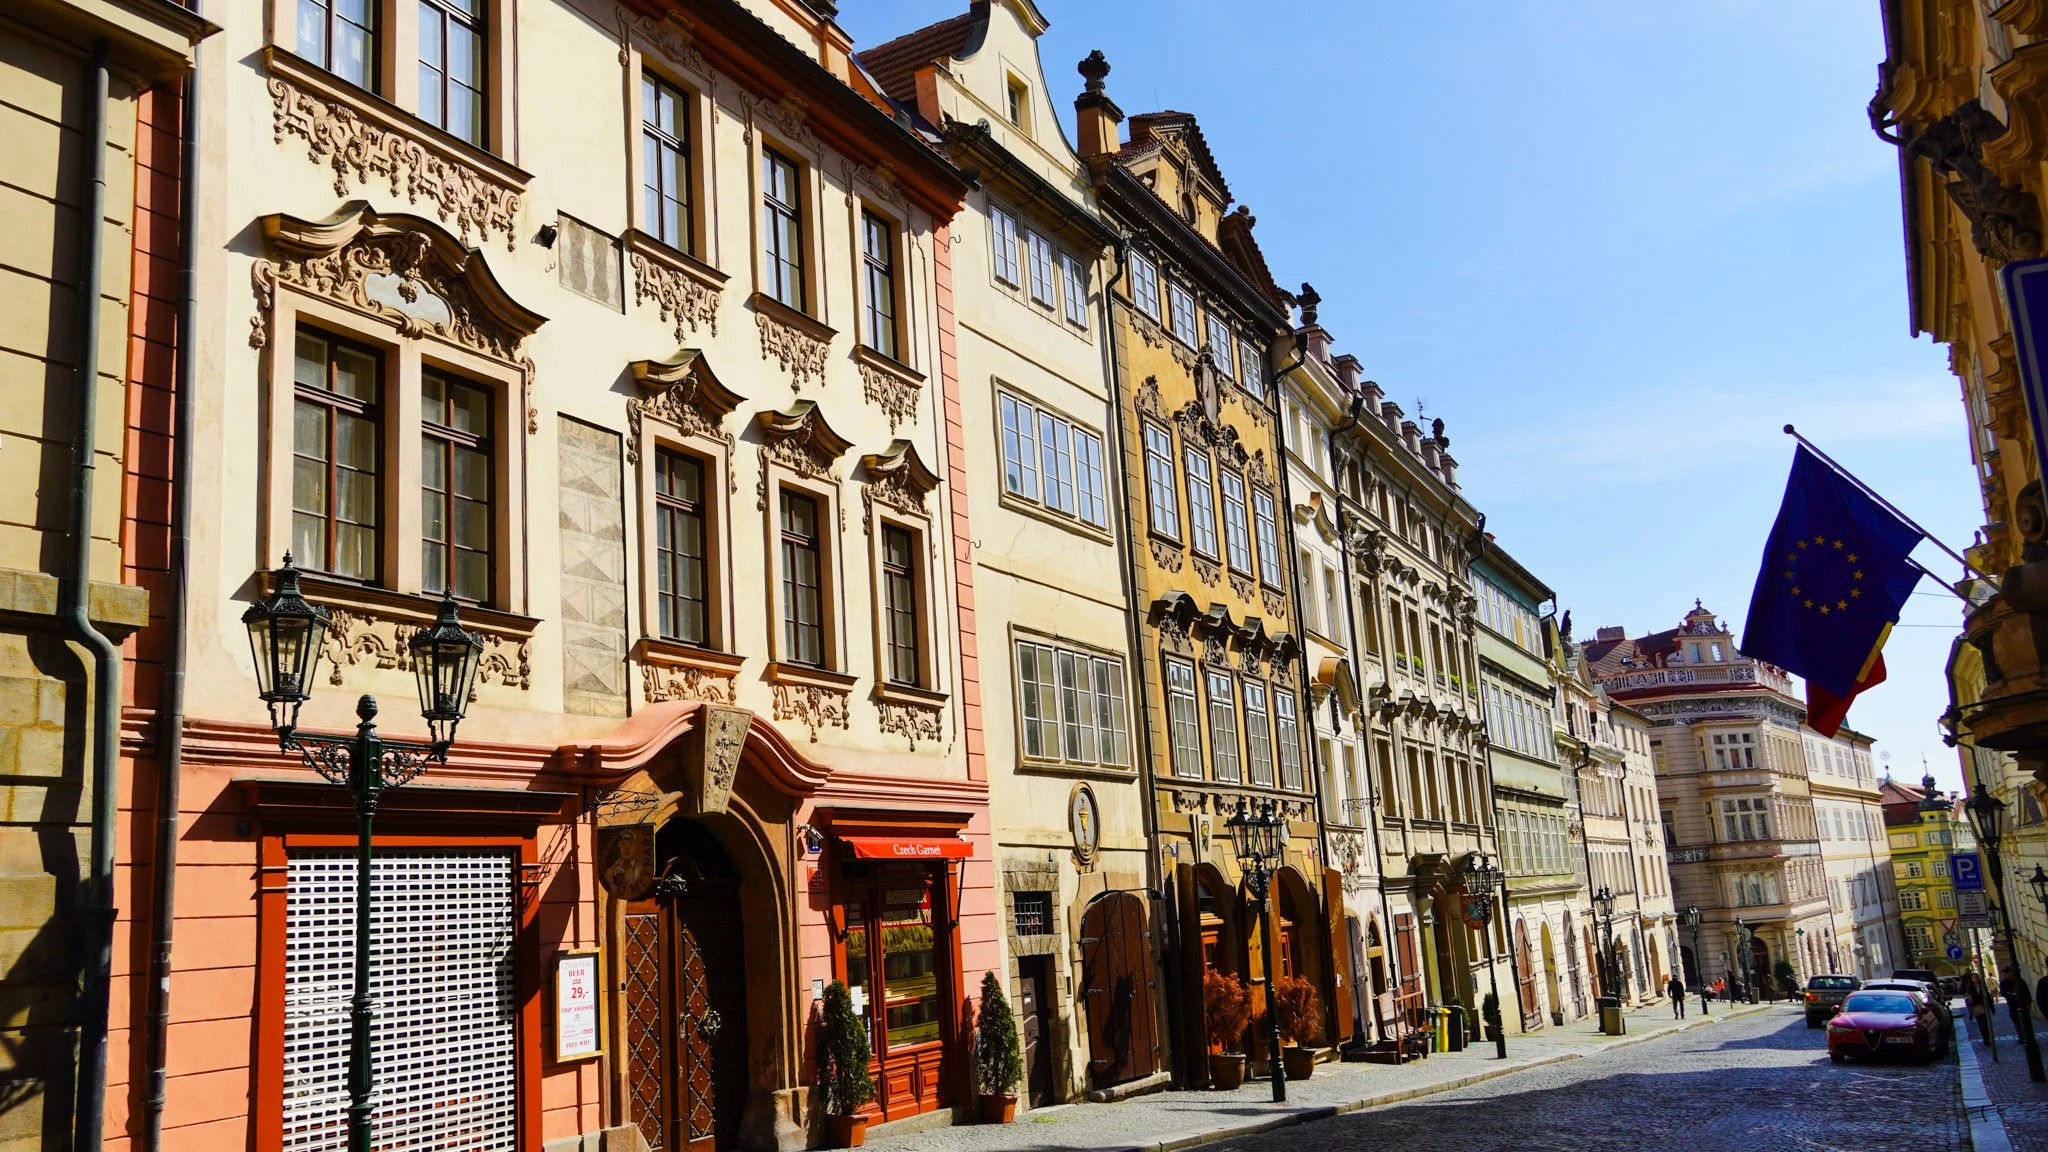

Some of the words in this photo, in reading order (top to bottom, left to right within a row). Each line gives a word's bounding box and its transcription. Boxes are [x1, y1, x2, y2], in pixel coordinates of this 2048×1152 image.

[893, 844, 916, 855] Czech
[916, 844, 941, 856] Garnet
[1956, 858, 1974, 880] P
[568, 969, 585, 977] BEER
[571, 986, 589, 999] 29,-
